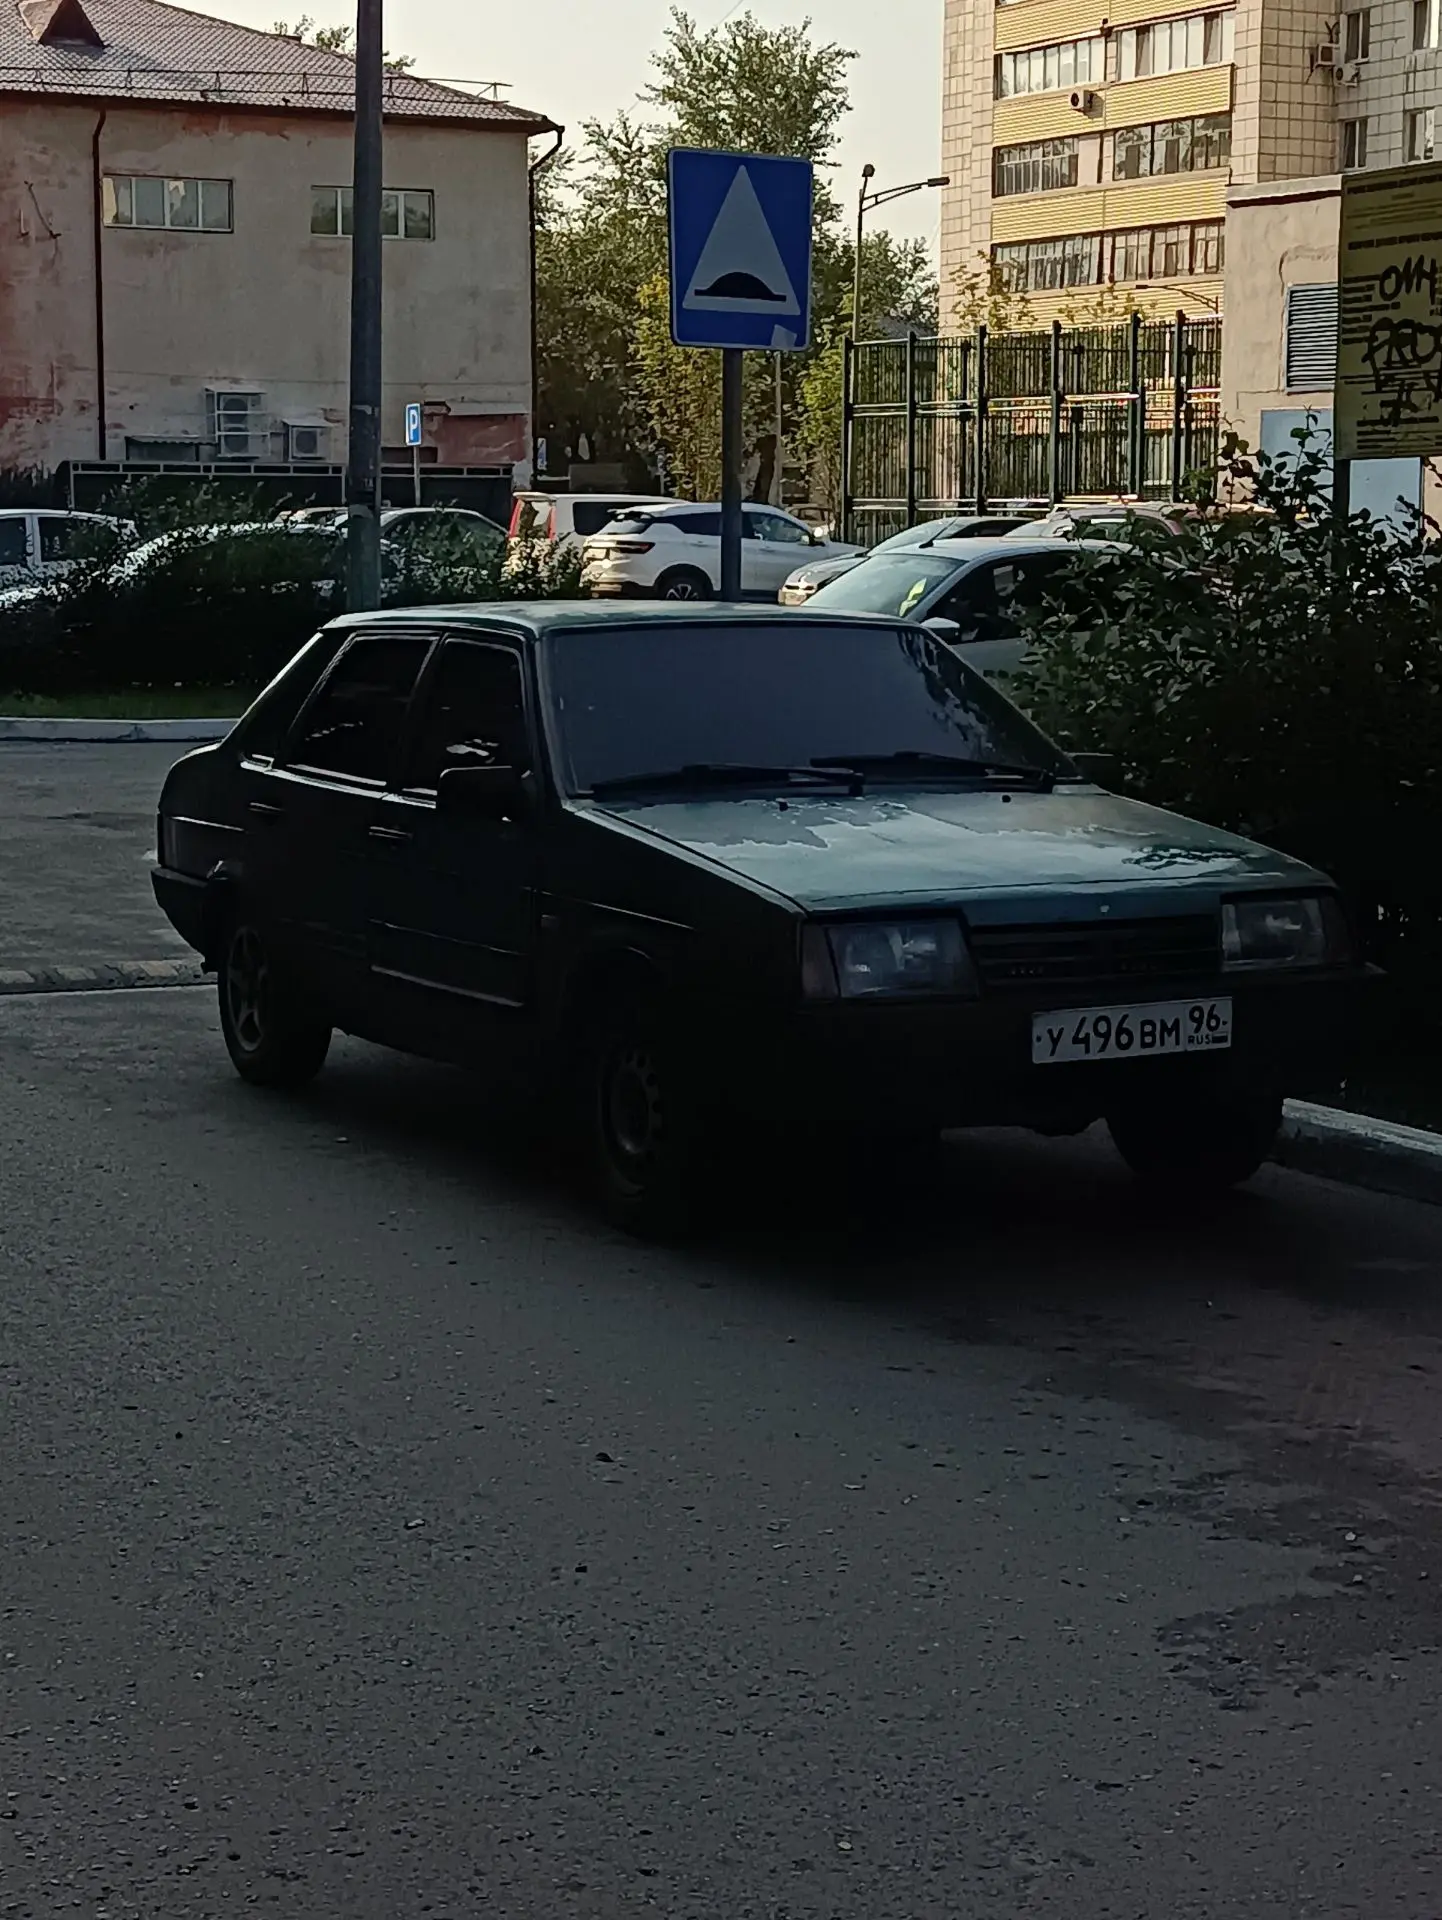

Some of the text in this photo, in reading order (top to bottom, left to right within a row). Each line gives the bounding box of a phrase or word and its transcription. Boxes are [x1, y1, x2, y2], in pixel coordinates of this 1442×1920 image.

[410, 410, 418, 441] P
[1188, 1004, 1221, 1033] 96
[1187, 1034, 1211, 1045] RUS
